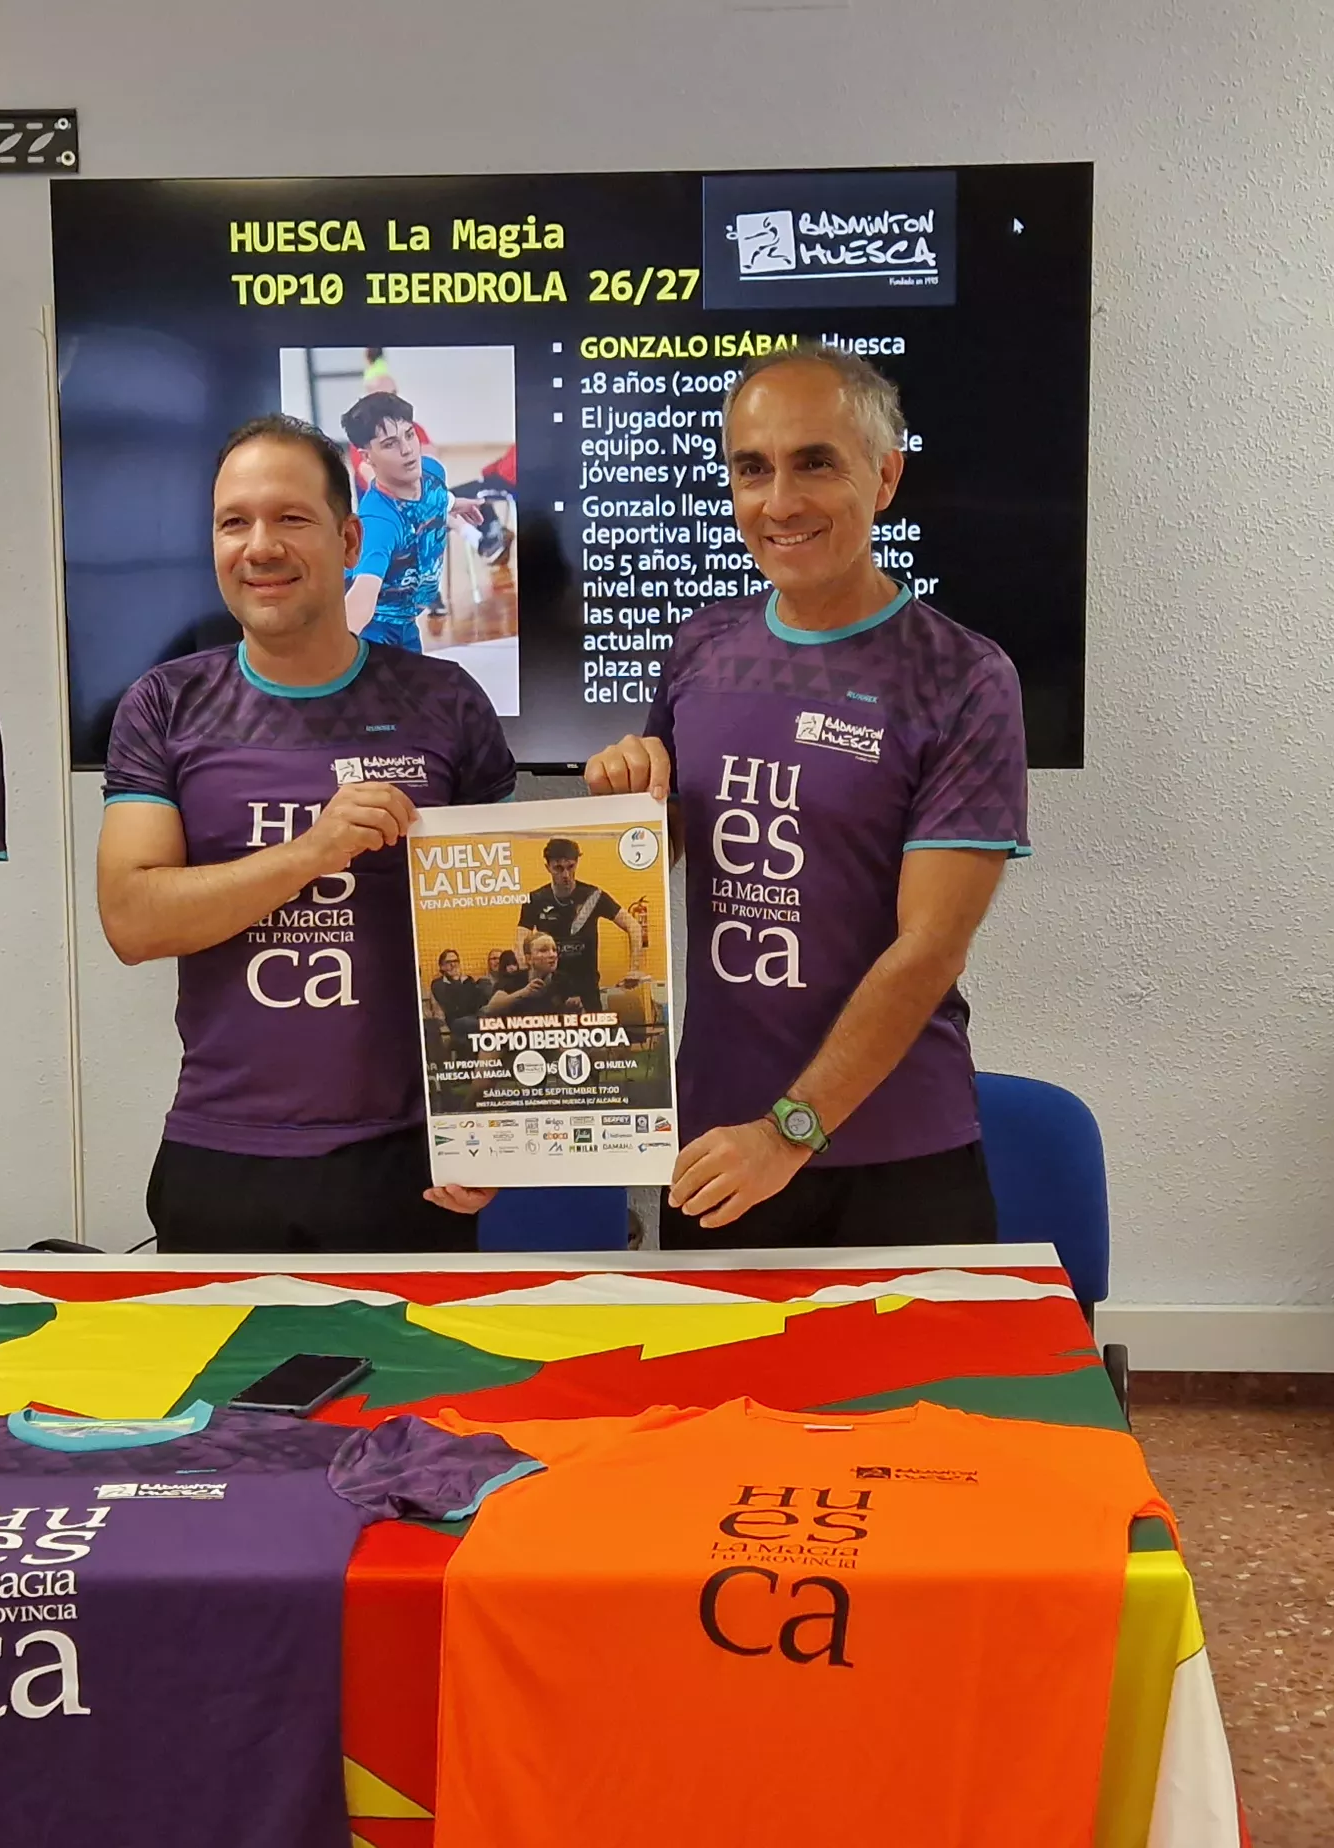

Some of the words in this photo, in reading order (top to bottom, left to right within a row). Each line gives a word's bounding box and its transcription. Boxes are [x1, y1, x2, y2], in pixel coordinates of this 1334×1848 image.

[230, 221, 365, 253] HUESCA
[387, 220, 430, 251] La
[452, 215, 565, 258] Magia
[799, 237, 936, 266] HUESCA
[231, 274, 343, 305] TOP10
[366, 271, 568, 304] IBERDROLA
[588, 267, 700, 306] 26/27
[580, 336, 708, 358] GONZALO
[580, 372, 607, 394] 18
[612, 372, 666, 393] años
[581, 405, 602, 429] El
[605, 404, 696, 435] jugador
[581, 433, 666, 461] equipo.
[579, 460, 668, 489] jóvenes
[673, 465, 687, 488] y
[582, 493, 676, 518] Gonzalo
[681, 493, 733, 517] lleva
[582, 521, 690, 550] deportiva
[582, 548, 615, 571] los
[619, 553, 632, 576] 5
[638, 549, 698, 575] años,
[582, 574, 635, 597] nivel
[641, 580, 668, 597] en
[673, 574, 738, 597] todas
[583, 601, 614, 625] las
[618, 607, 661, 630] que
[584, 654, 643, 683] plaza
[584, 681, 618, 703] del
[415, 842, 511, 870] VUELVE
[712, 808, 805, 881] es
[419, 872, 453, 897] LA
[456, 866, 521, 895] LIGA!
[420, 899, 441, 910] VEN
[442, 899, 452, 908] A
[453, 898, 474, 908] POR
[474, 897, 488, 906] TU
[711, 920, 807, 989] ca
[246, 948, 360, 1009] ca
[479, 1018, 504, 1031] LIGA
[507, 1015, 561, 1029] NACIONAL
[564, 1014, 578, 1027] DE
[468, 1031, 526, 1052] TOP10
[529, 1027, 630, 1049] IBERDROLA
[719, 1509, 868, 1544] es
[699, 1565, 854, 1669] ca
